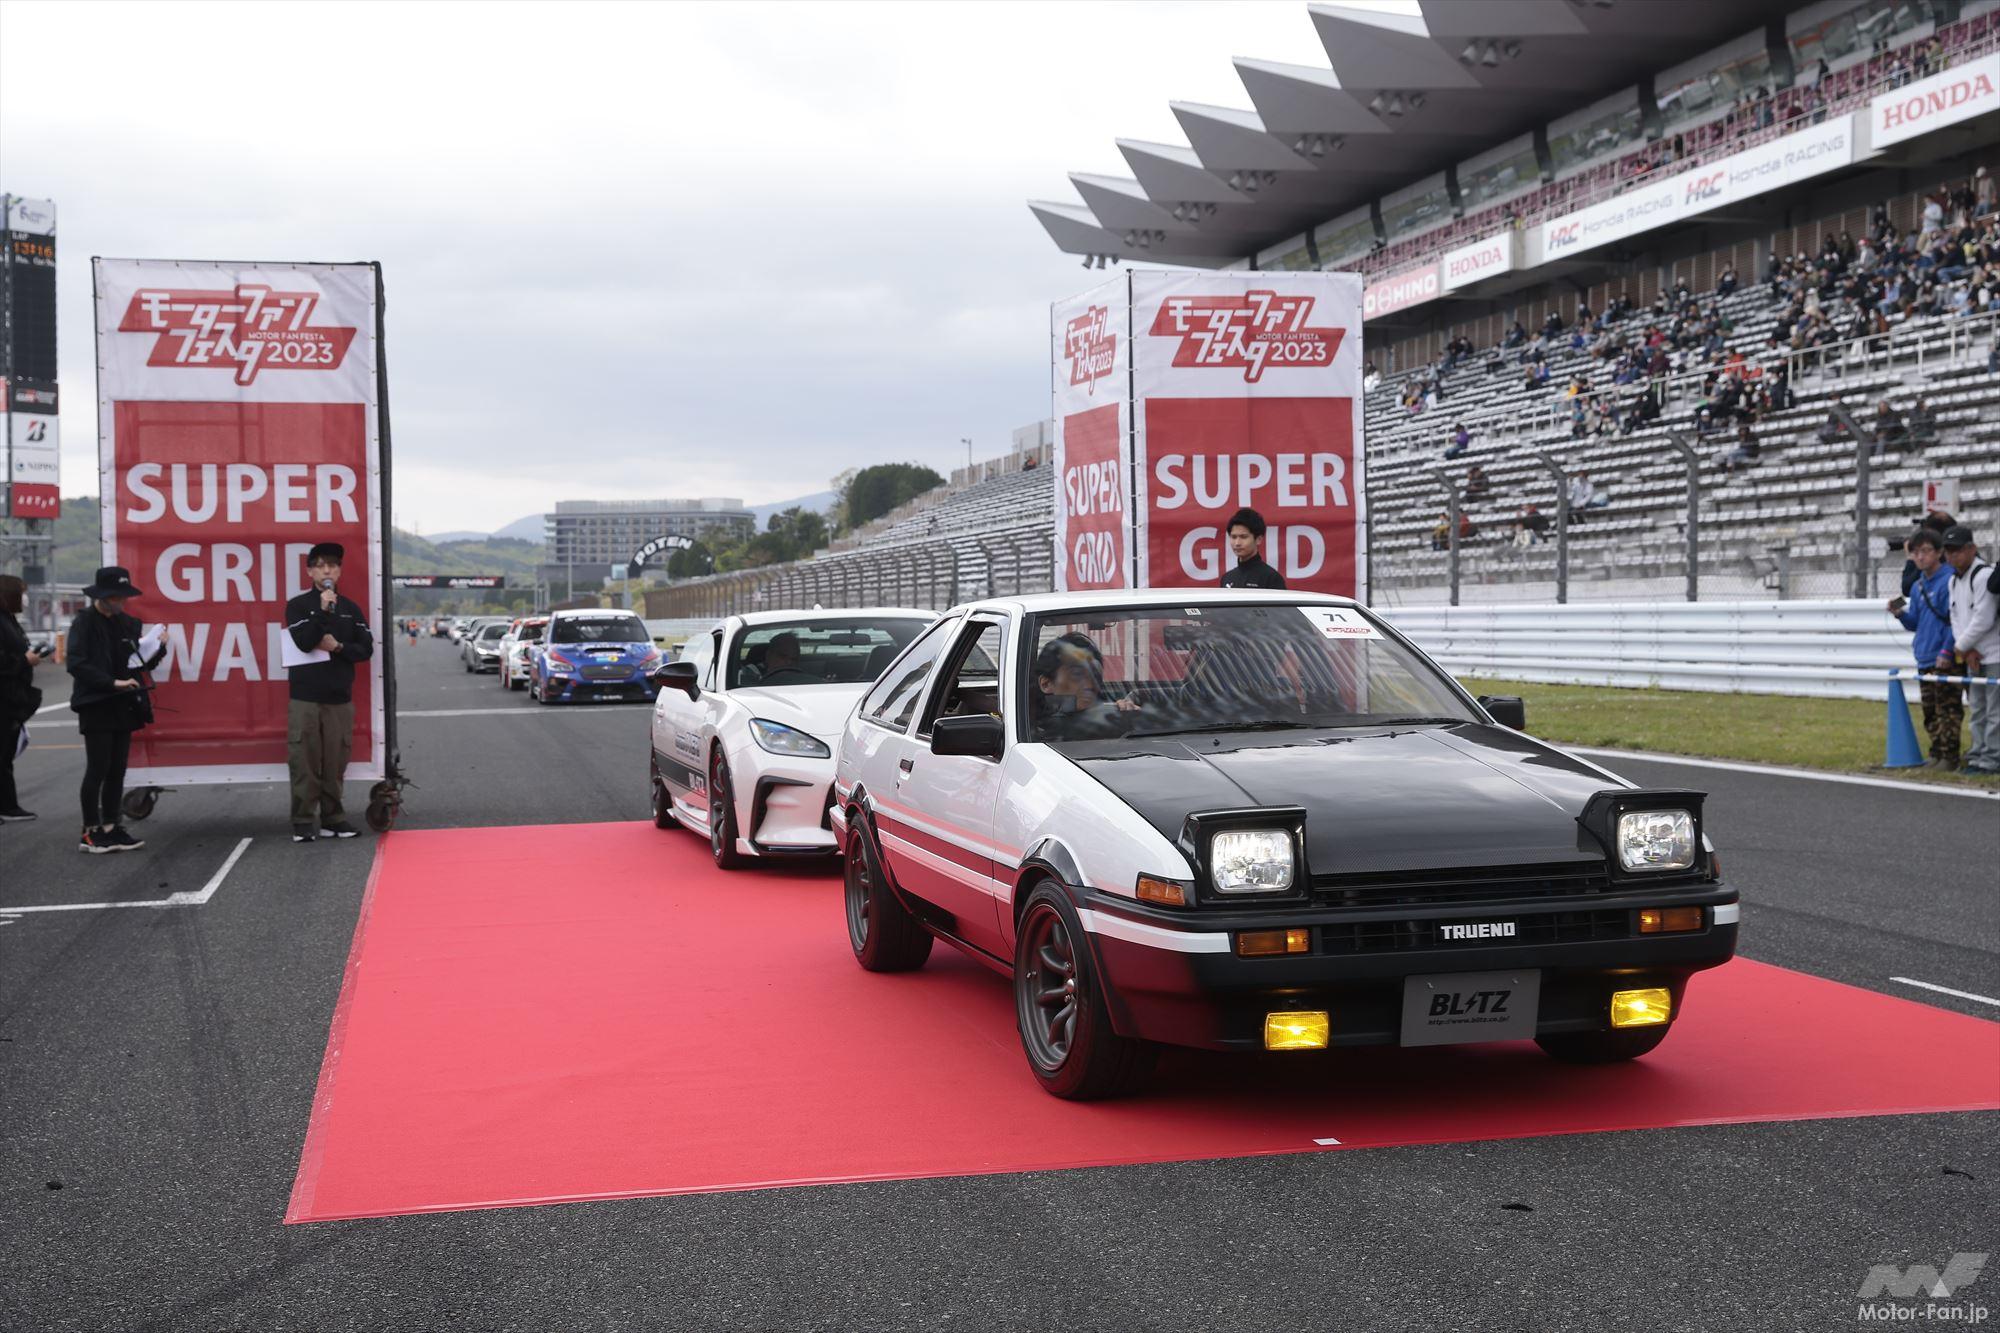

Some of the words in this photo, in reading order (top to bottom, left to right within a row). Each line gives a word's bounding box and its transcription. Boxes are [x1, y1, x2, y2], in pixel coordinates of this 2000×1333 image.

[1883, 73, 1994, 130] HONDA
[1729, 160, 1782, 185] Honda
[1784, 134, 1845, 167] RACING
[1584, 212, 1625, 235] Honda
[1626, 193, 1673, 221] RACING
[1450, 247, 1503, 278] HONDA
[1392, 273, 1438, 300] HINO
[248, 332, 280, 340] MOTOR
[281, 332, 299, 341] FAN
[300, 333, 325, 341] FESTA
[266, 342, 334, 363] 2023
[1271, 341, 1327, 362] 2023
[125, 462, 360, 524] SUPER
[1066, 459, 1122, 517] SUPER
[1154, 453, 1349, 509] SUPER
[1074, 530, 1117, 584] GRID
[1178, 525, 1326, 581] GID
[142, 622, 289, 683] WAL
[1440, 922, 1516, 940] TRUENO
[1428, 990, 1511, 1017] BLITZ
